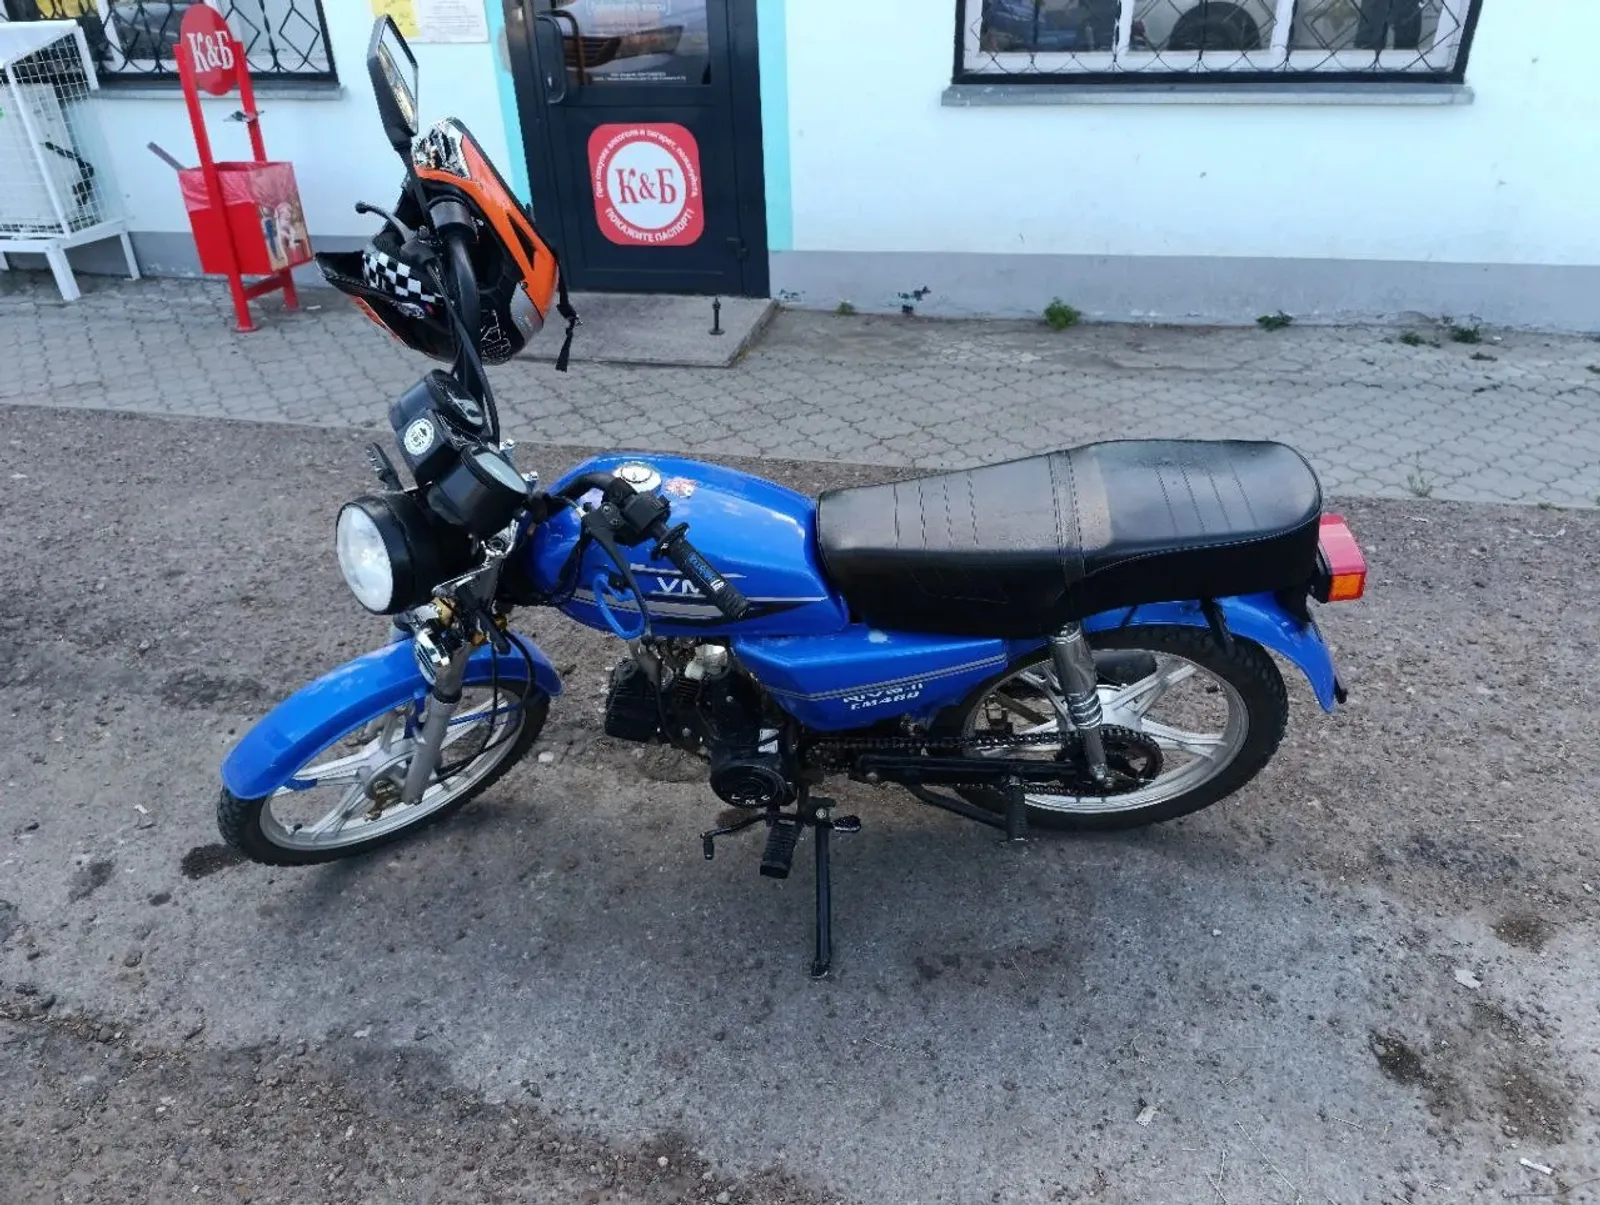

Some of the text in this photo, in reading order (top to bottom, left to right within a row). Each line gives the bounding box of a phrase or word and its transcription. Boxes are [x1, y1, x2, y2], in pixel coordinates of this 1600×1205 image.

[186, 29, 235, 73] К&Б
[615, 168, 678, 204] К&Б
[605, 208, 695, 242] ПОКАЖИТЕ ПАСПОРТ!
